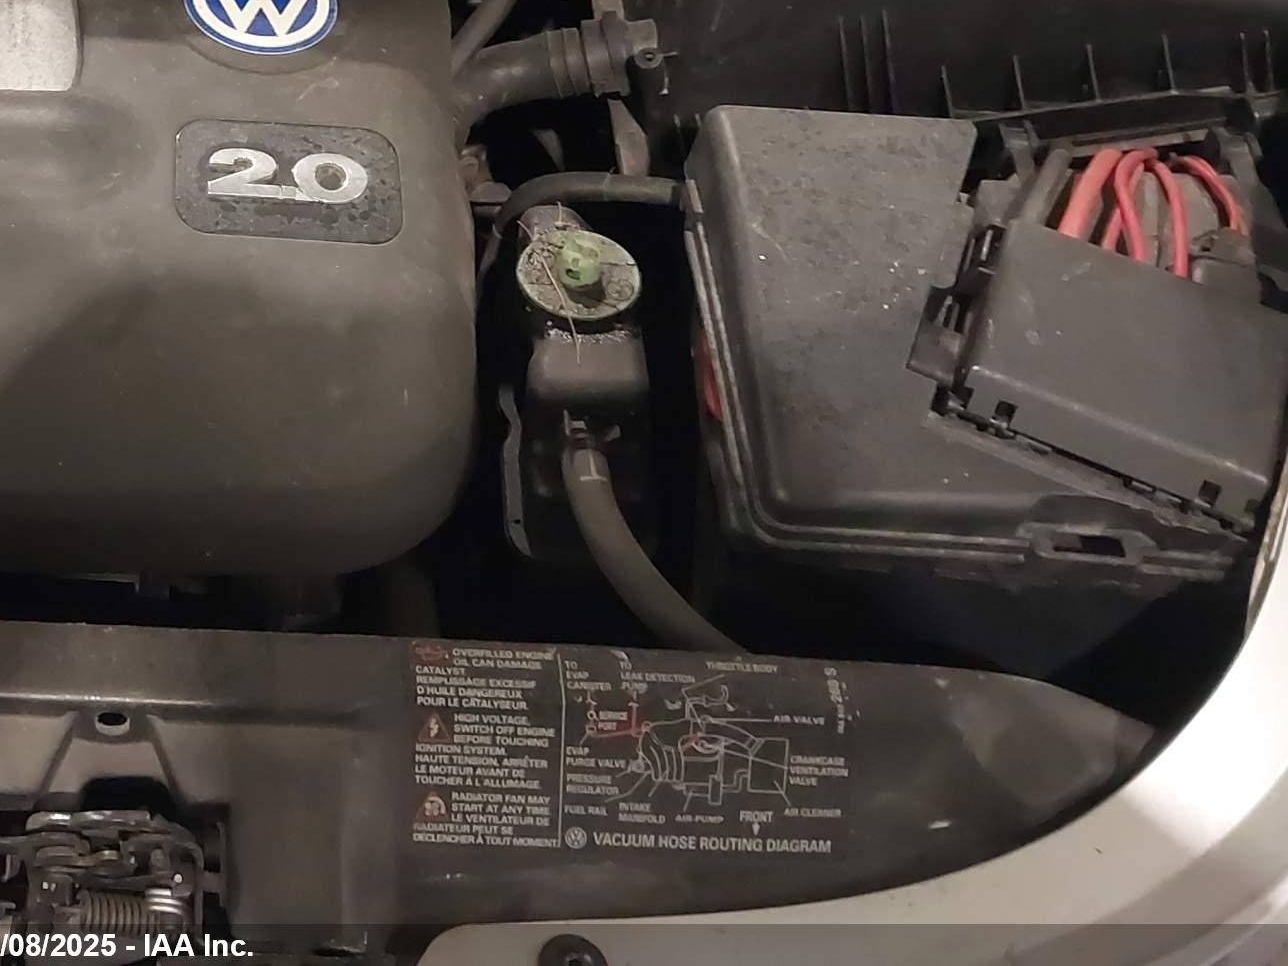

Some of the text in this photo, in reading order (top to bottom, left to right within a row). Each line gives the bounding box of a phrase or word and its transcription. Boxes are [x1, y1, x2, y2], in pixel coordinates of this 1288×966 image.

[453, 648, 554, 661] OVERFILLED ENGINE
[415, 665, 466, 675] CATALYST
[472, 659, 495, 668] CAN
[496, 660, 542, 670] DAMAGE
[564, 660, 578, 670] TO
[619, 660, 632, 670] TO
[566, 670, 590, 680] EVAP
[620, 671, 696, 683] LEAK DETECTION
[417, 697, 446, 707] POUR
[447, 698, 460, 707] LE
[454, 713, 480, 723] HIGH
[773, 714, 825, 726] AIR VALVE
[454, 724, 556, 737] SWITCH OFF ENGINE
[453, 734, 549, 748] BEFORE TOUCHING
[415, 743, 461, 754] IGNITION
[566, 746, 590, 757] EVAP
[415, 754, 450, 764] HAUTE
[789, 755, 845, 766] CRANKCASE
[415, 764, 526, 779] LE MOTEUR AVANT DE
[789, 766, 849, 777] VENTILATION
[414, 775, 463, 786] TOUCHER
[788, 777, 819, 786] VALVE
[451, 792, 551, 805] RADIATOR FAN MAY
[451, 802, 484, 813] START
[485, 804, 499, 813] AT
[502, 805, 523, 815] ANY
[564, 805, 609, 817] FUEL RAIL
[783, 807, 842, 819] AIR CLEANER
[451, 813, 550, 827] LE VENTILATEUR DE
[618, 813, 666, 824] MANIFOLD
[739, 810, 774, 823] FRONT
[413, 822, 513, 835] RADIATEUR PEUT SE
[485, 835, 512, 846] TOUT
[593, 831, 832, 853] VACUUM HOSE ROUTING DIAGRAM
